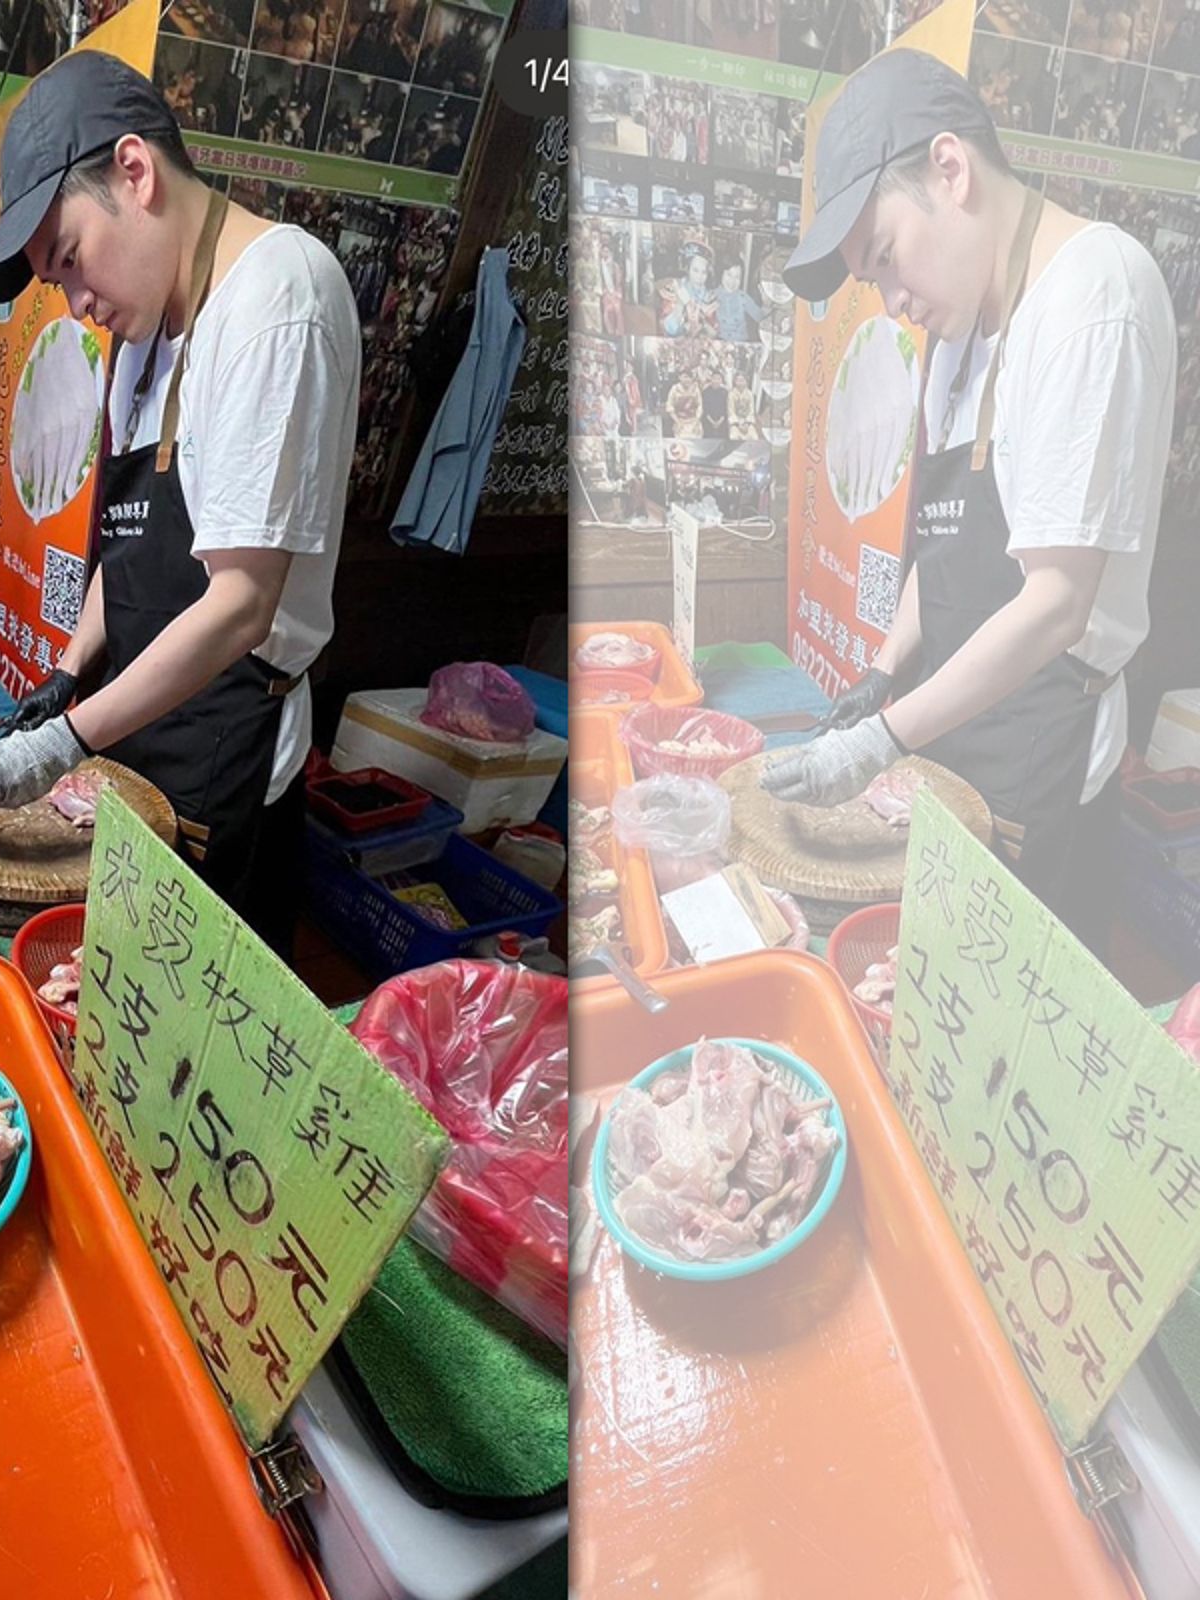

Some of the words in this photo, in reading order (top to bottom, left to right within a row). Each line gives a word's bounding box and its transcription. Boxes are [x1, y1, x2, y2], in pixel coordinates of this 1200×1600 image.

[796, 587, 880, 674] 加盟批發專
[150, 1131, 291, 1401] 250元
